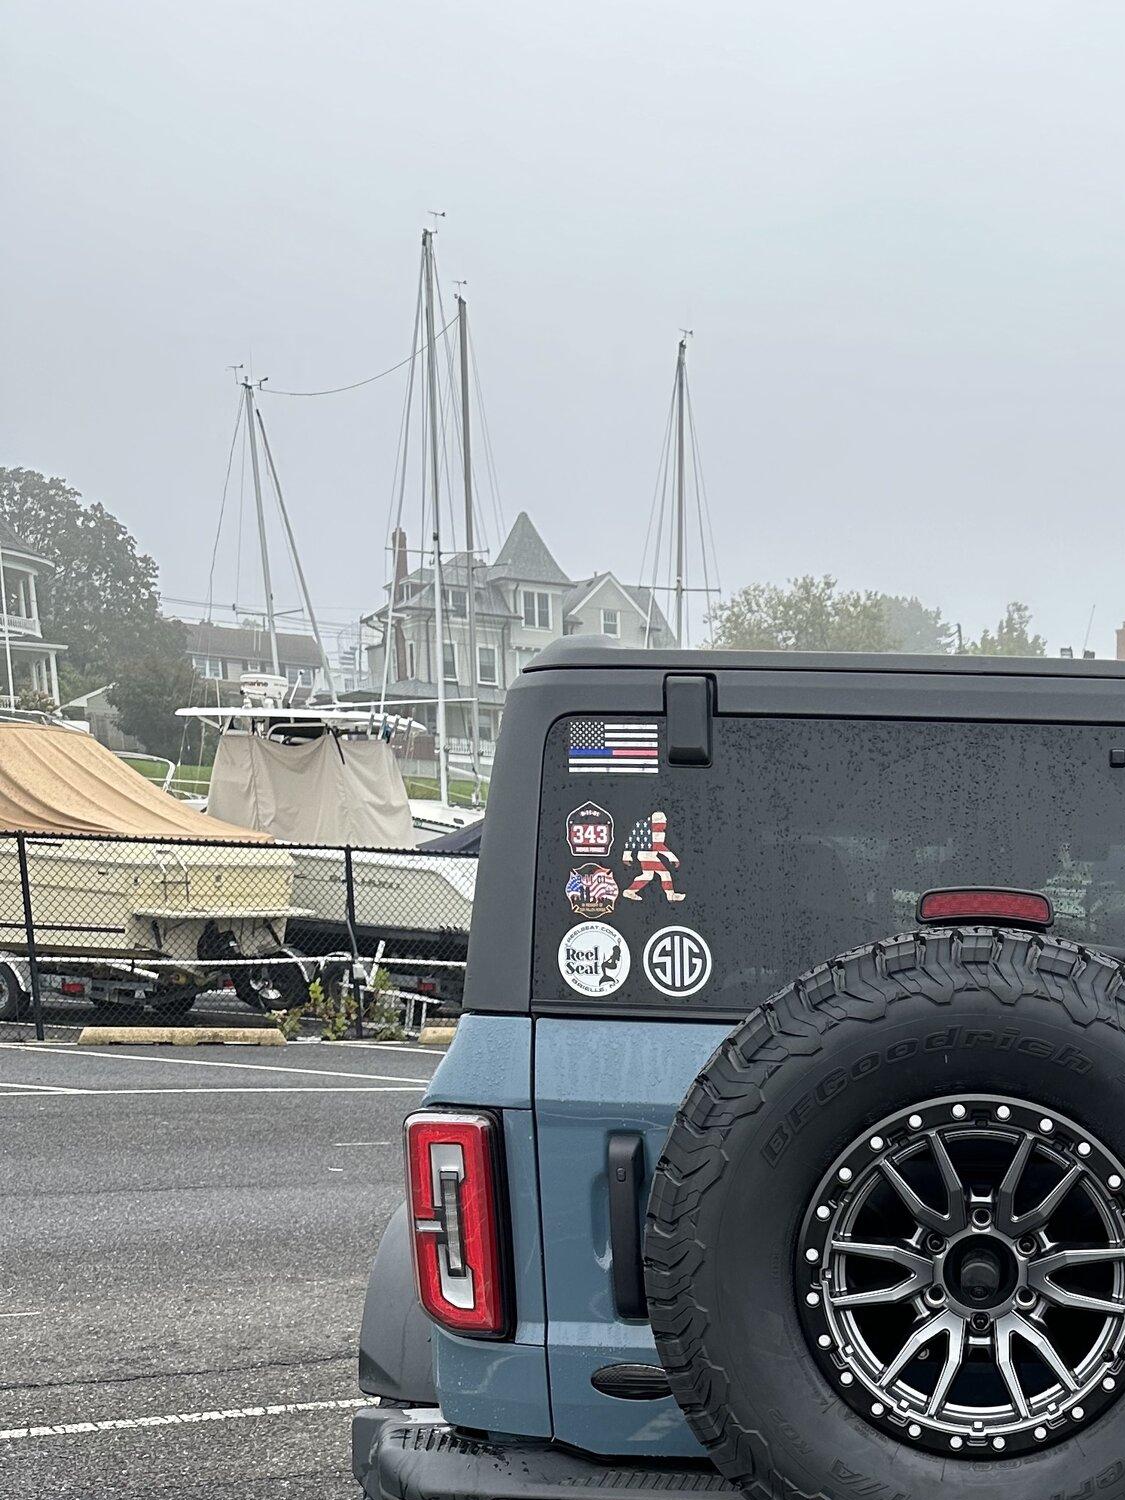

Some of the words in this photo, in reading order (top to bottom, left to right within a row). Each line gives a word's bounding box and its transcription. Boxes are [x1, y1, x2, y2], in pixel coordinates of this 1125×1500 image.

[573, 825, 608, 845] 343
[566, 946, 599, 962] Reel
[652, 936, 703, 988] SIG
[566, 962, 600, 975] Seat
[762, 1024, 1096, 1168] BFGoodrich
